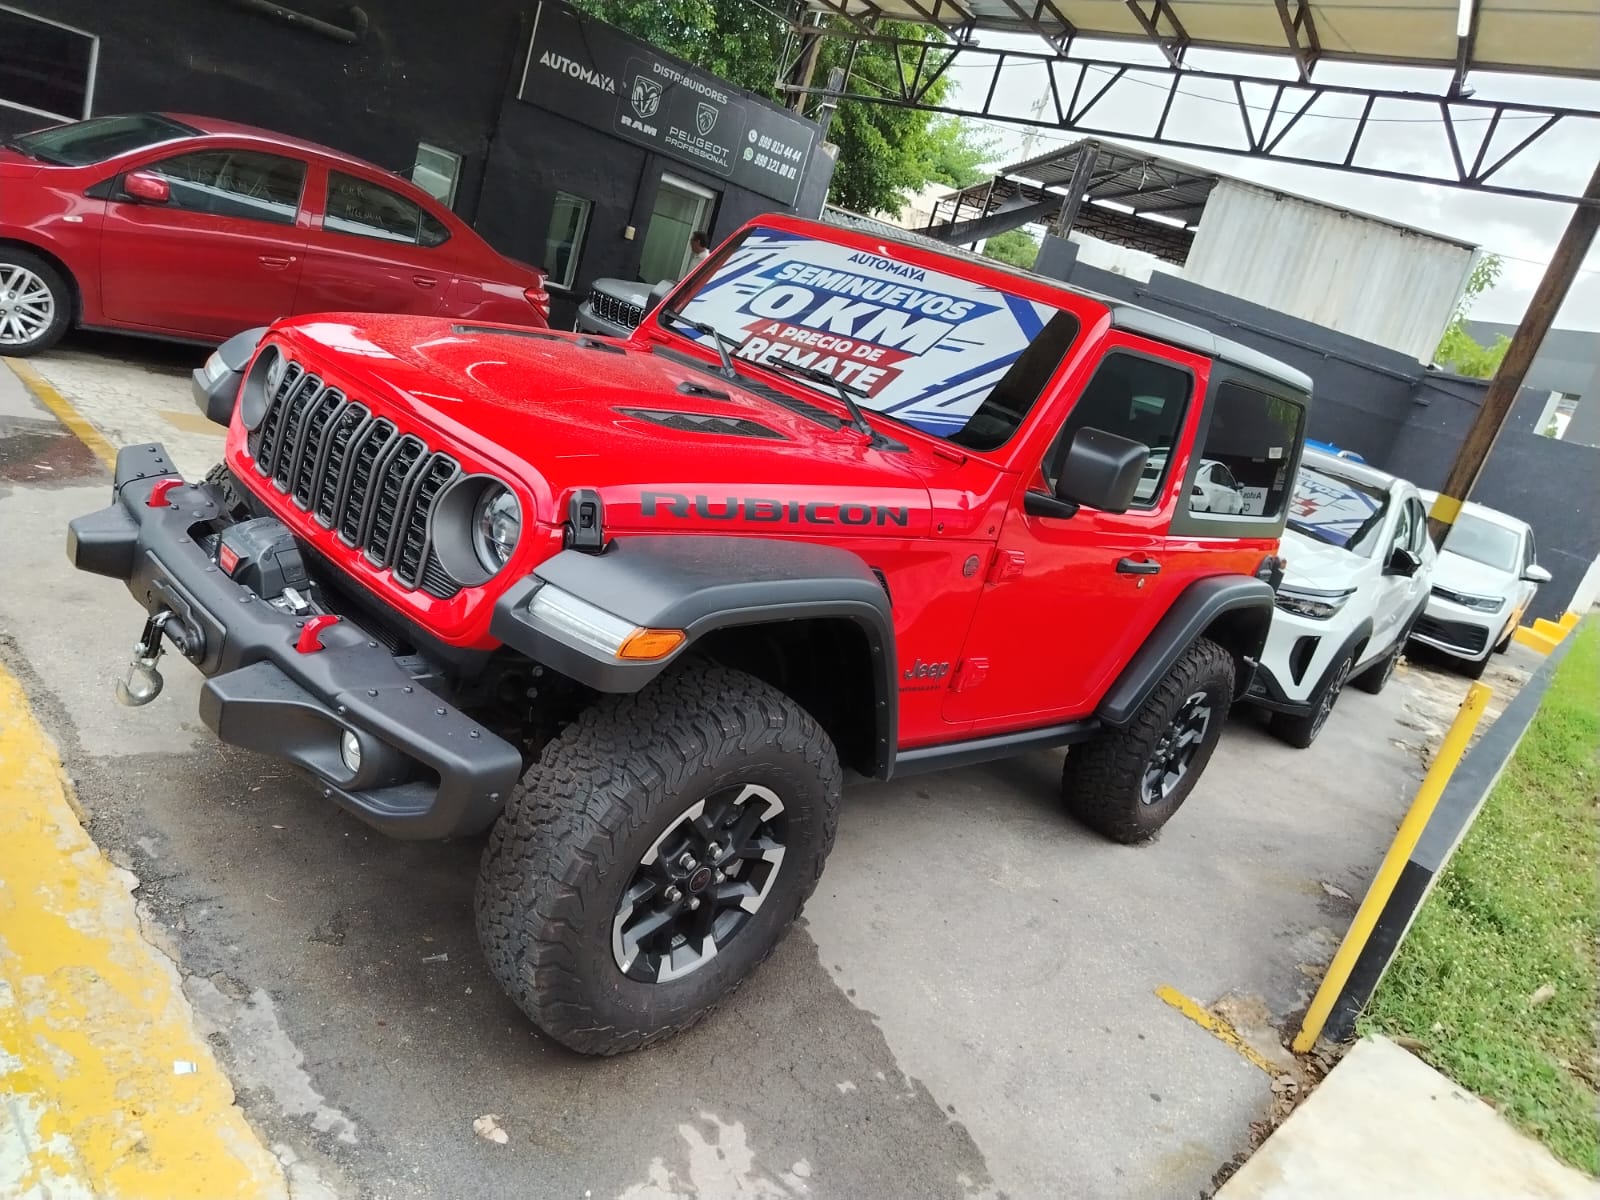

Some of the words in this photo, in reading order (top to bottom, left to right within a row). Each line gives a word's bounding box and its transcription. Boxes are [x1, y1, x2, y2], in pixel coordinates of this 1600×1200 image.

[539, 50, 616, 95] AUTOMAYA
[652, 62, 729, 105] DISTRIBUIDORES
[620, 114, 658, 137] RAM
[669, 126, 730, 158] PEUGEOT
[664, 136, 729, 168] PROFESSIONAL
[783, 146, 794, 159] 44
[791, 150, 803, 163] 44
[847, 253, 926, 283] AUTOMAYA
[775, 263, 976, 320] SEMINUEVOS
[762, 322, 781, 336] A
[779, 326, 854, 353] PRECIO
[851, 344, 887, 362] DE
[800, 296, 954, 356] KM
[735, 336, 888, 393] REMATE
[640, 491, 909, 527] RUBICON
[904, 658, 950, 681] Jeep
